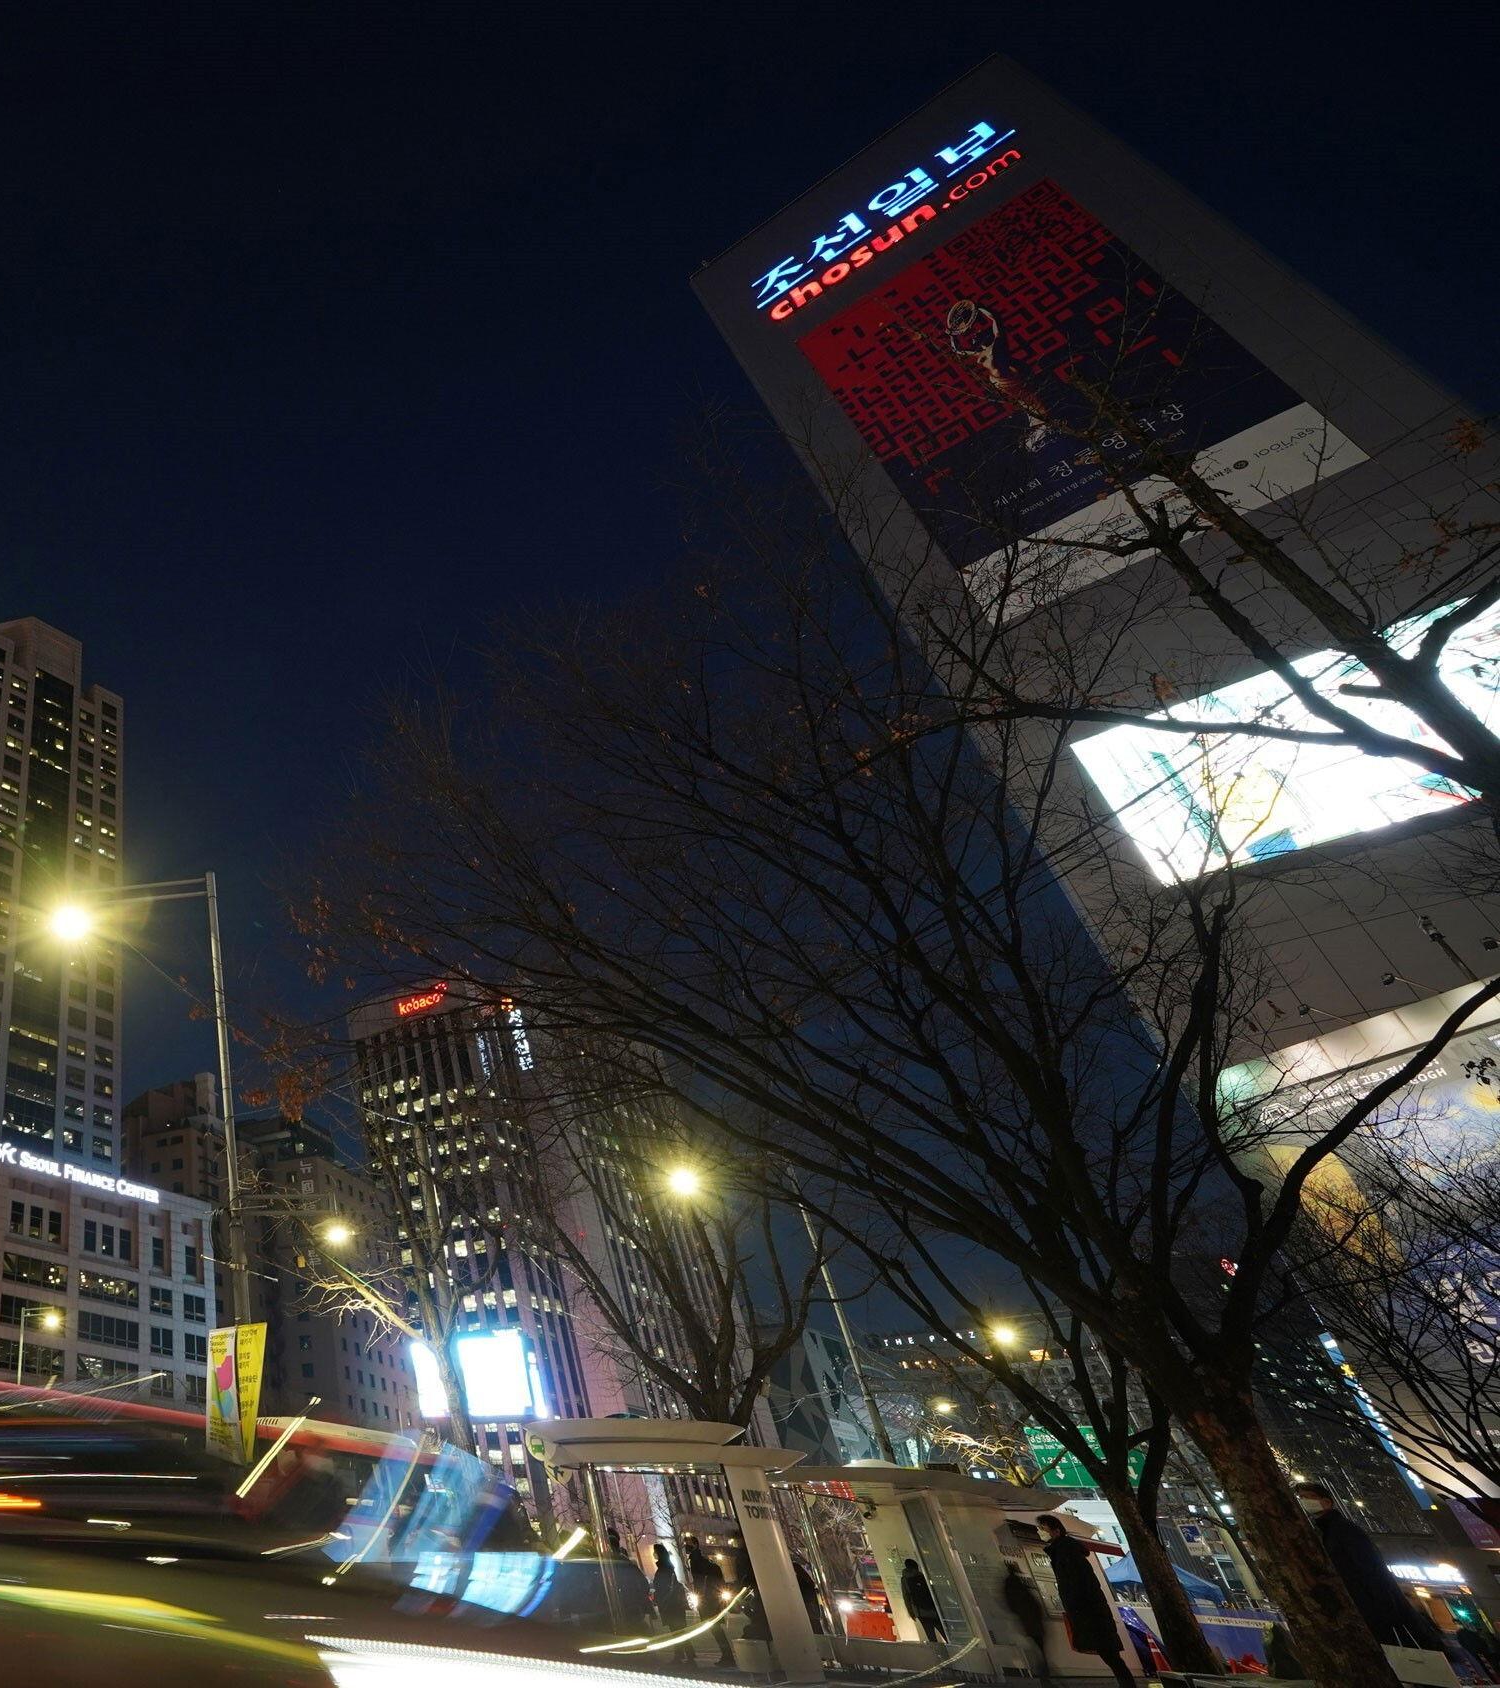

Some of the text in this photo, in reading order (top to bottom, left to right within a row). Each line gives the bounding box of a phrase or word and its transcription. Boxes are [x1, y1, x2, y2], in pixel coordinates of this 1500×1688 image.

[751, 121, 1016, 309] 조선일보
[770, 149, 1021, 320] chosun.com
[398, 993, 441, 1016] kobaco
[883, 1336, 915, 1347] THE
